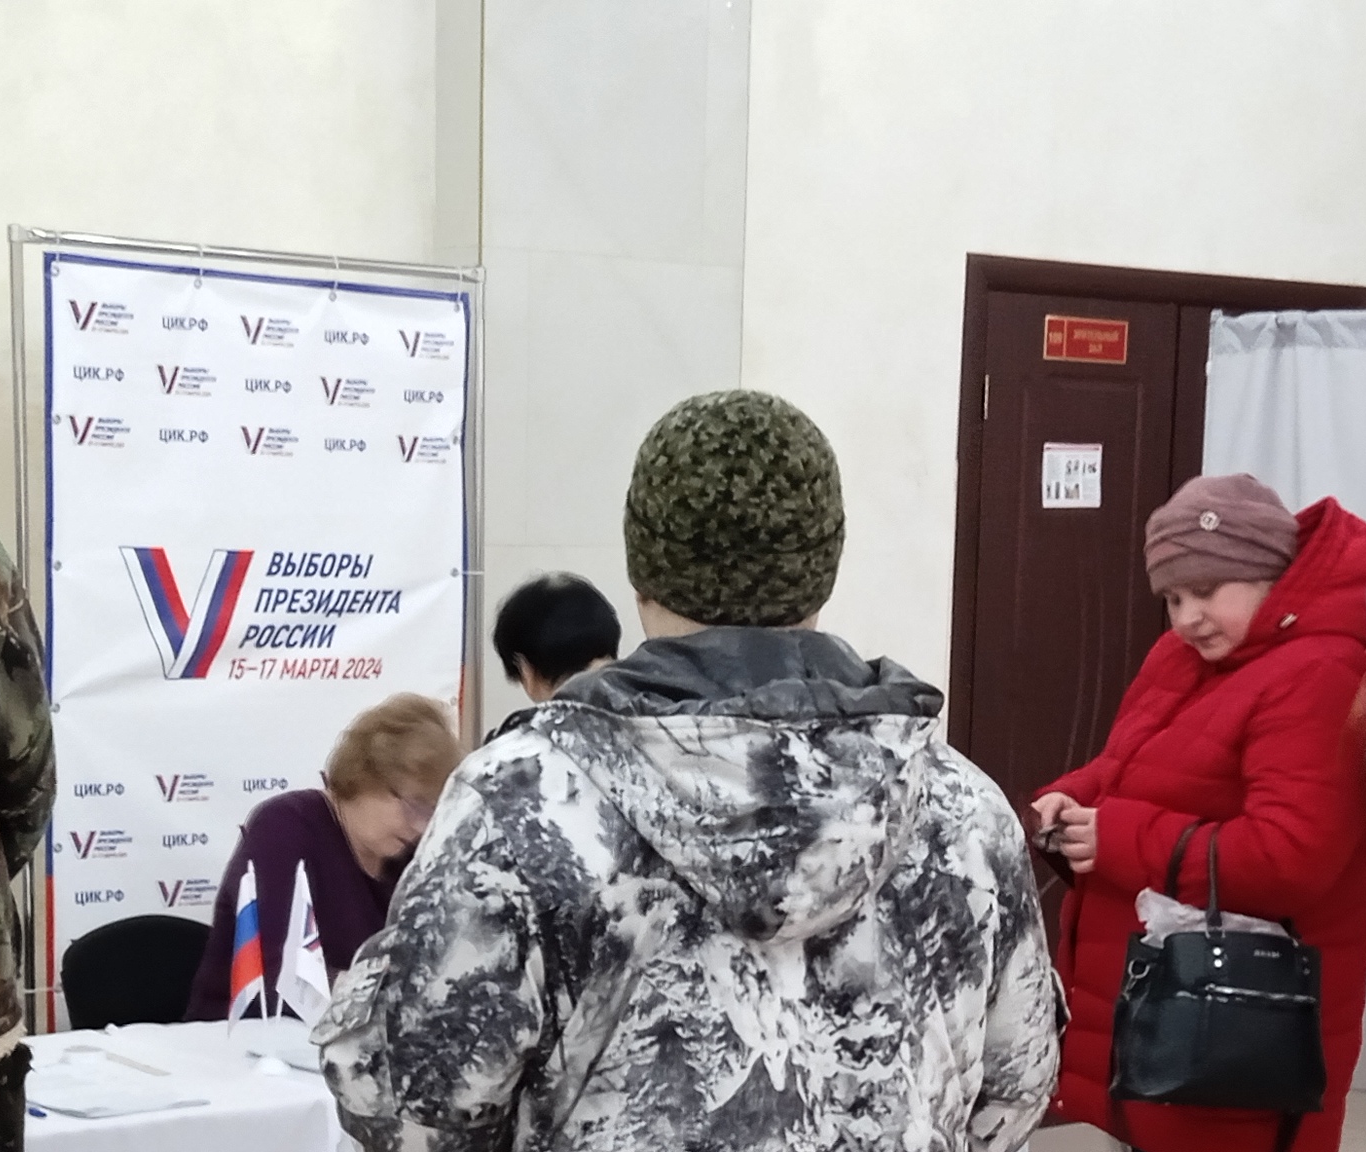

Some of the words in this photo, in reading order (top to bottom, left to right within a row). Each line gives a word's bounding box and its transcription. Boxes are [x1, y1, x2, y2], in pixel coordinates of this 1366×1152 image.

[266, 552, 373, 578] ВЫБОРЫ
[254, 588, 402, 617] ПРЕЗИДЕНТА
[238, 624, 336, 648] РОССИИ
[280, 658, 339, 679] МАРТА
[342, 658, 383, 679] 2024
[74, 783, 125, 798] ЦИК.РФ
[243, 778, 288, 792] ЦИК.РФ
[163, 833, 208, 849] ЦИК.РФ
[75, 890, 124, 906] ЦИК.РФ
